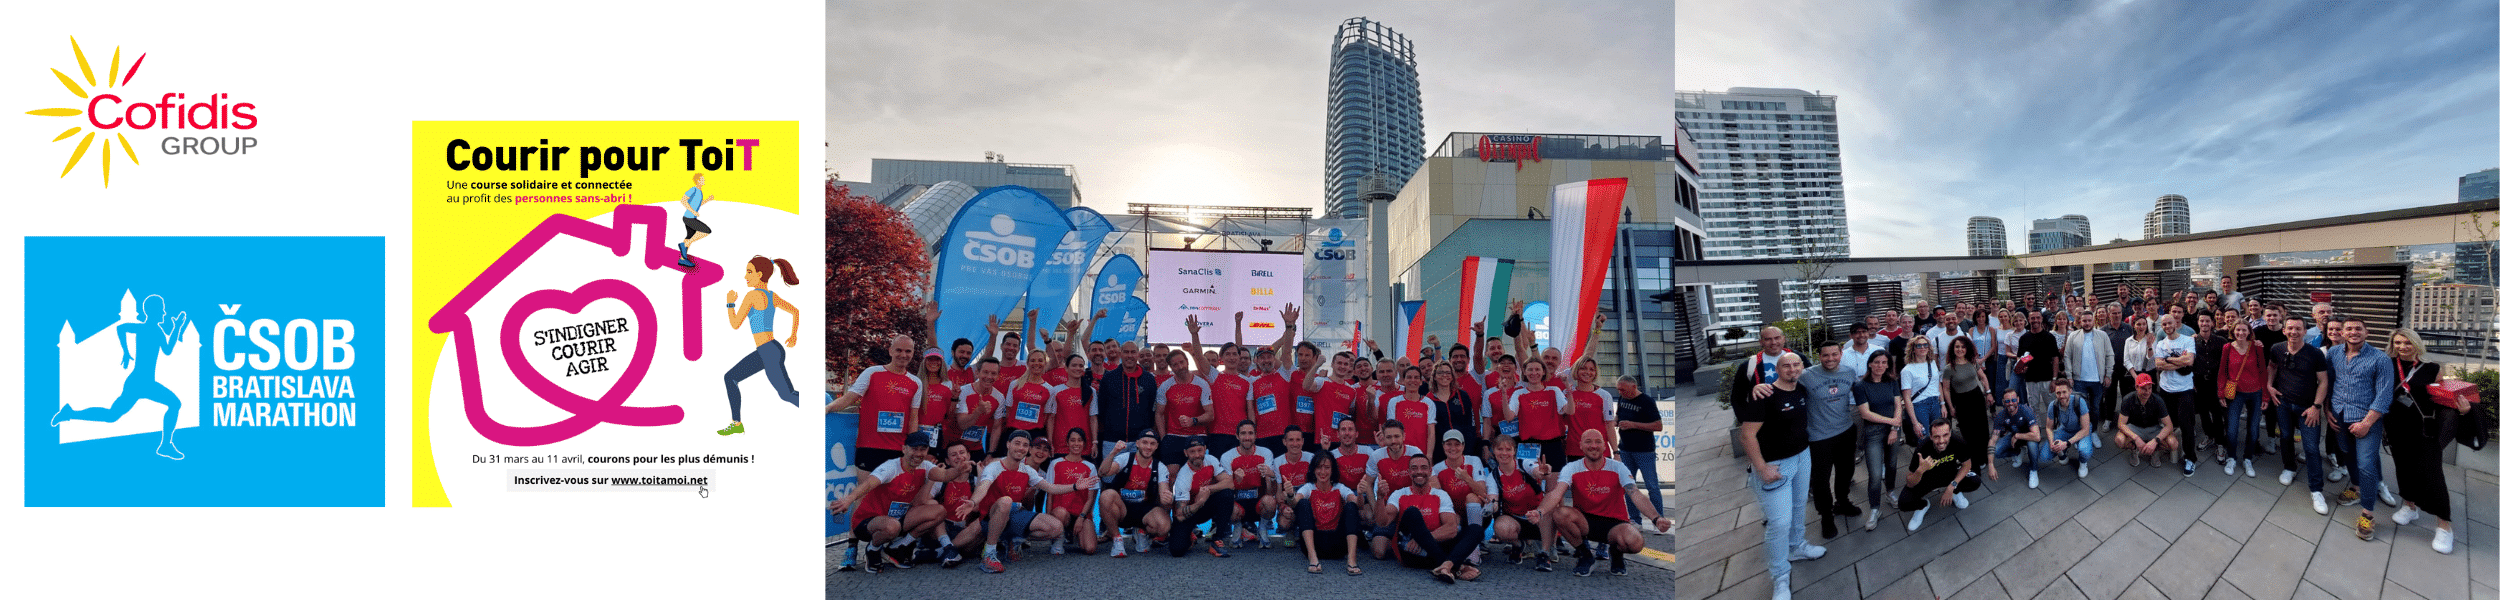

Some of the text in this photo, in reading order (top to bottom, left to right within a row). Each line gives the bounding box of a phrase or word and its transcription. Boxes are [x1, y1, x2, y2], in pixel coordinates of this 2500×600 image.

[88, 93, 258, 130] Cofidis
[162, 137, 258, 155] GROUP
[447, 139, 760, 178] Courir pour ToiT
[446, 181, 467, 189] Une
[510, 180, 558, 189] solidaire
[561, 181, 572, 189] et
[575, 180, 632, 189] connectée
[462, 193, 491, 205] profit
[494, 194, 512, 203] des
[515, 195, 573, 205] personnes
[575, 194, 626, 203] sans-abri
[962, 239, 1035, 269] ČSOB
[1178, 267, 1213, 276] SanaClis
[1250, 287, 1274, 297] BILLA
[213, 304, 355, 371] ČSOB
[533, 317, 630, 346] S'INDIGNER
[551, 337, 617, 361] COURIR
[566, 356, 609, 377] AGIR
[213, 376, 355, 398] BRATISLAVA
[213, 403, 356, 427] MARATHON
[472, 455, 486, 463] Du
[489, 455, 500, 463] 31
[547, 455, 558, 463] 11
[561, 455, 585, 465] avril,
[633, 457, 658, 465] pour
[661, 455, 675, 463] les
[678, 455, 700, 465] plus
[703, 454, 749, 463] démunis
[514, 475, 708, 486] Inscrivez-vous sur www.toitamoi.net
